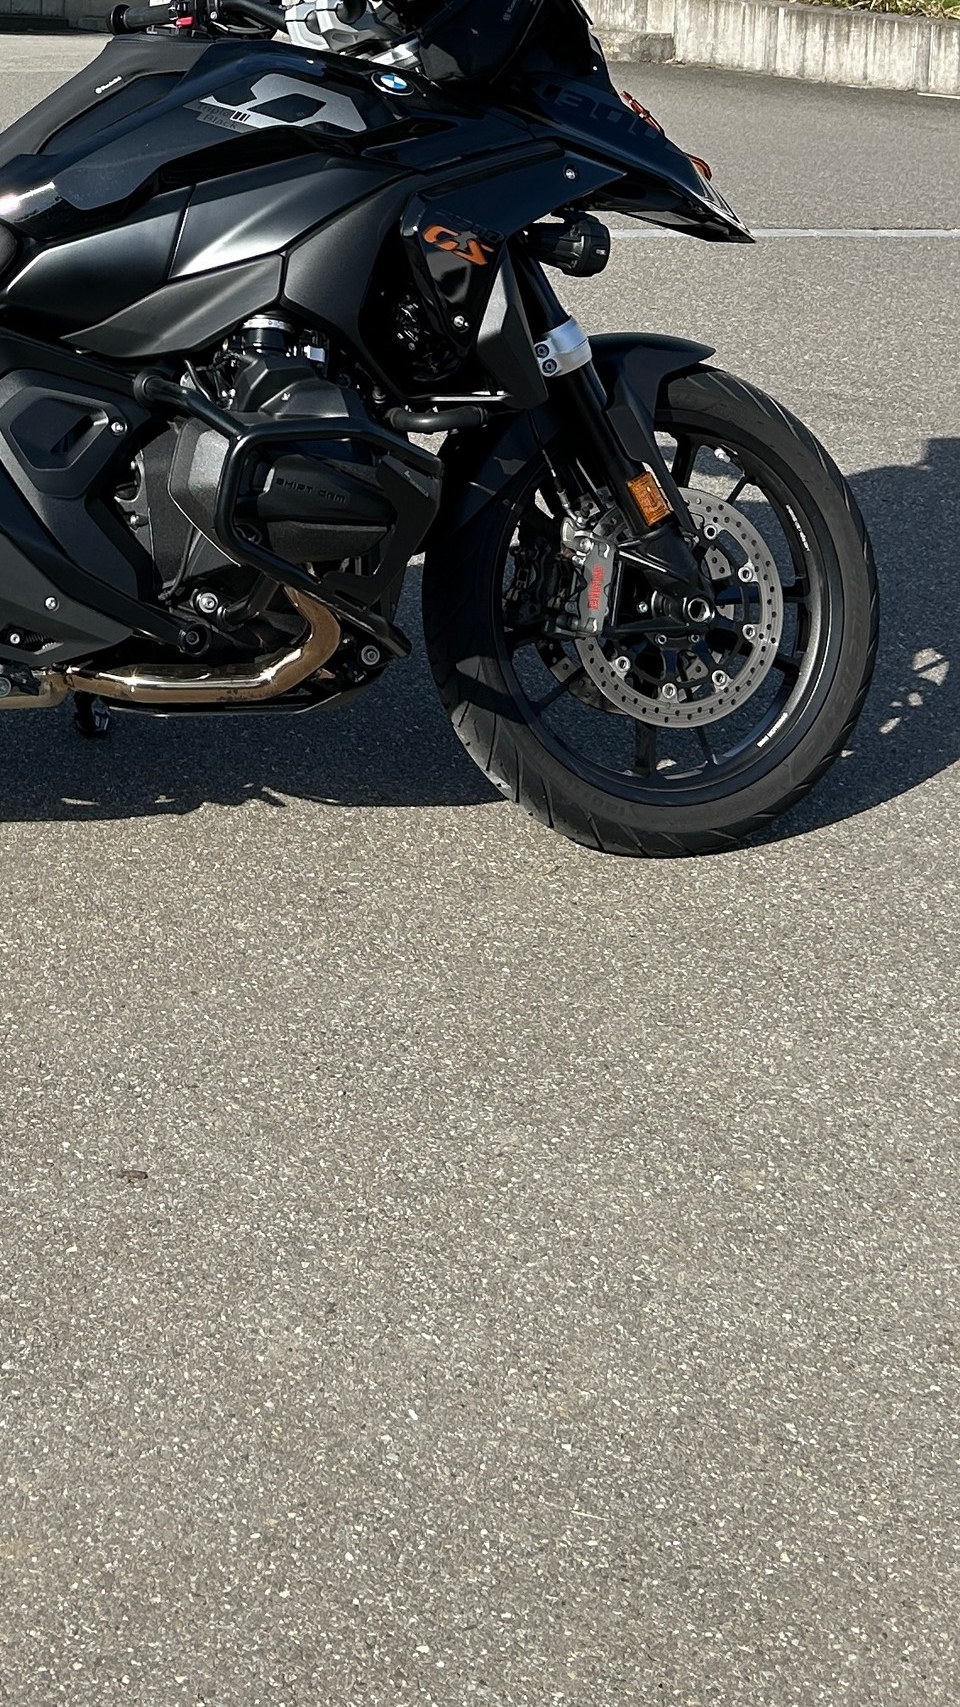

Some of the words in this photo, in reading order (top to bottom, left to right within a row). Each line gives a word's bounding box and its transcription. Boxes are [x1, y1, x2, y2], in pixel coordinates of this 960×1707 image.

[197, 103, 230, 117] Triple
[203, 114, 238, 130] Black
[423, 224, 495, 266] GS
[276, 477, 313, 494] SHIFT
[318, 489, 347, 504] CAM
